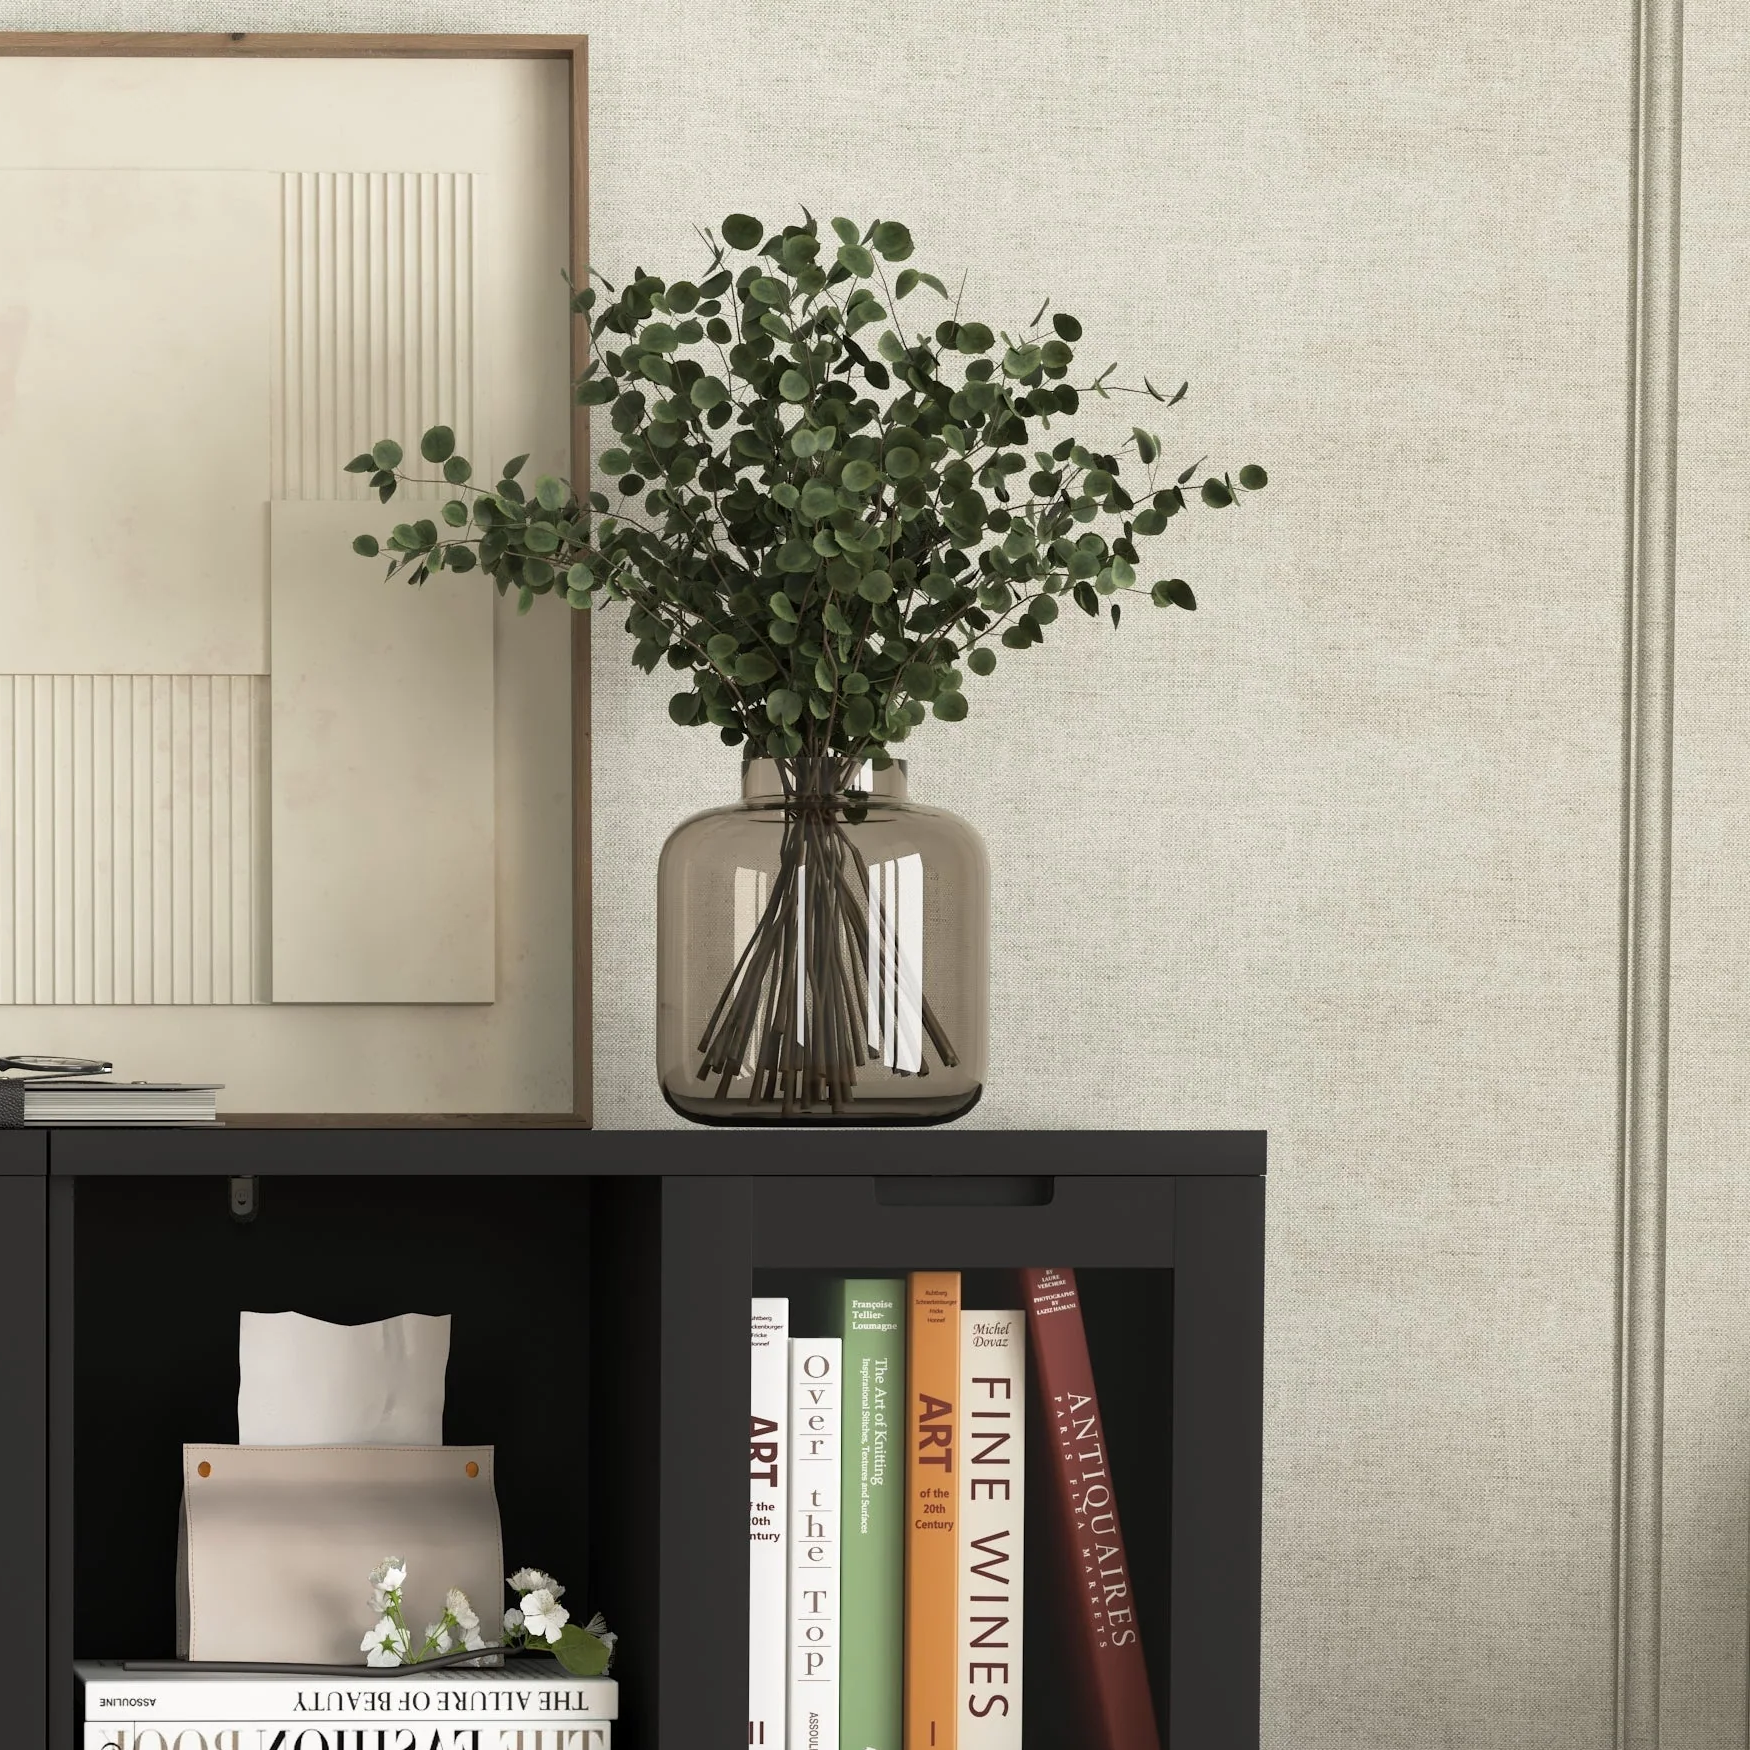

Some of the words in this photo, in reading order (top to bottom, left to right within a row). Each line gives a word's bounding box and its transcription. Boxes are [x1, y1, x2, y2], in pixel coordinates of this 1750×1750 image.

[852, 1300, 893, 1310] Françoise
[852, 1311, 884, 1320] Tellier-
[852, 1321, 898, 1332] Loumagne
[972, 1322, 1012, 1337] Michel
[972, 1336, 1009, 1348] Dovaz
[874, 1357, 888, 1384] The
[860, 1358, 871, 1409] Inspirational
[874, 1386, 888, 1410] Art
[860, 1411, 871, 1445] Stitches,
[874, 1413, 888, 1428] of
[918, 1392, 953, 1473] ART
[970, 1377, 1011, 1501] FINE
[750, 1415, 779, 1488] ART
[870, 1430, 888, 1486] Knitting
[860, 1446, 871, 1481] Textures
[860, 1482, 871, 1498] and
[920, 1488, 932, 1499] of
[933, 1488, 950, 1499] the
[756, 1502, 775, 1511] the
[860, 1499, 871, 1534] Surfaces
[923, 1504, 946, 1514] 20th
[750, 1516, 771, 1526] 0th
[915, 1519, 954, 1532] Century
[1054, 1396, 1073, 1461] PARIS
[1069, 1480, 1085, 1530] FLEA
[1082, 1547, 1107, 1649] MARKETS
[1067, 1391, 1136, 1647] ANTIQUAIRES
[750, 1532, 781, 1543] ntury
[968, 1530, 1010, 1718] WINES
[99, 1698, 157, 1708] ASSOULINE
[293, 1691, 391, 1711] BEAUTY
[398, 1691, 434, 1711] OF
[437, 1691, 532, 1711] ALLURE
[538, 1691, 589, 1711] THE
